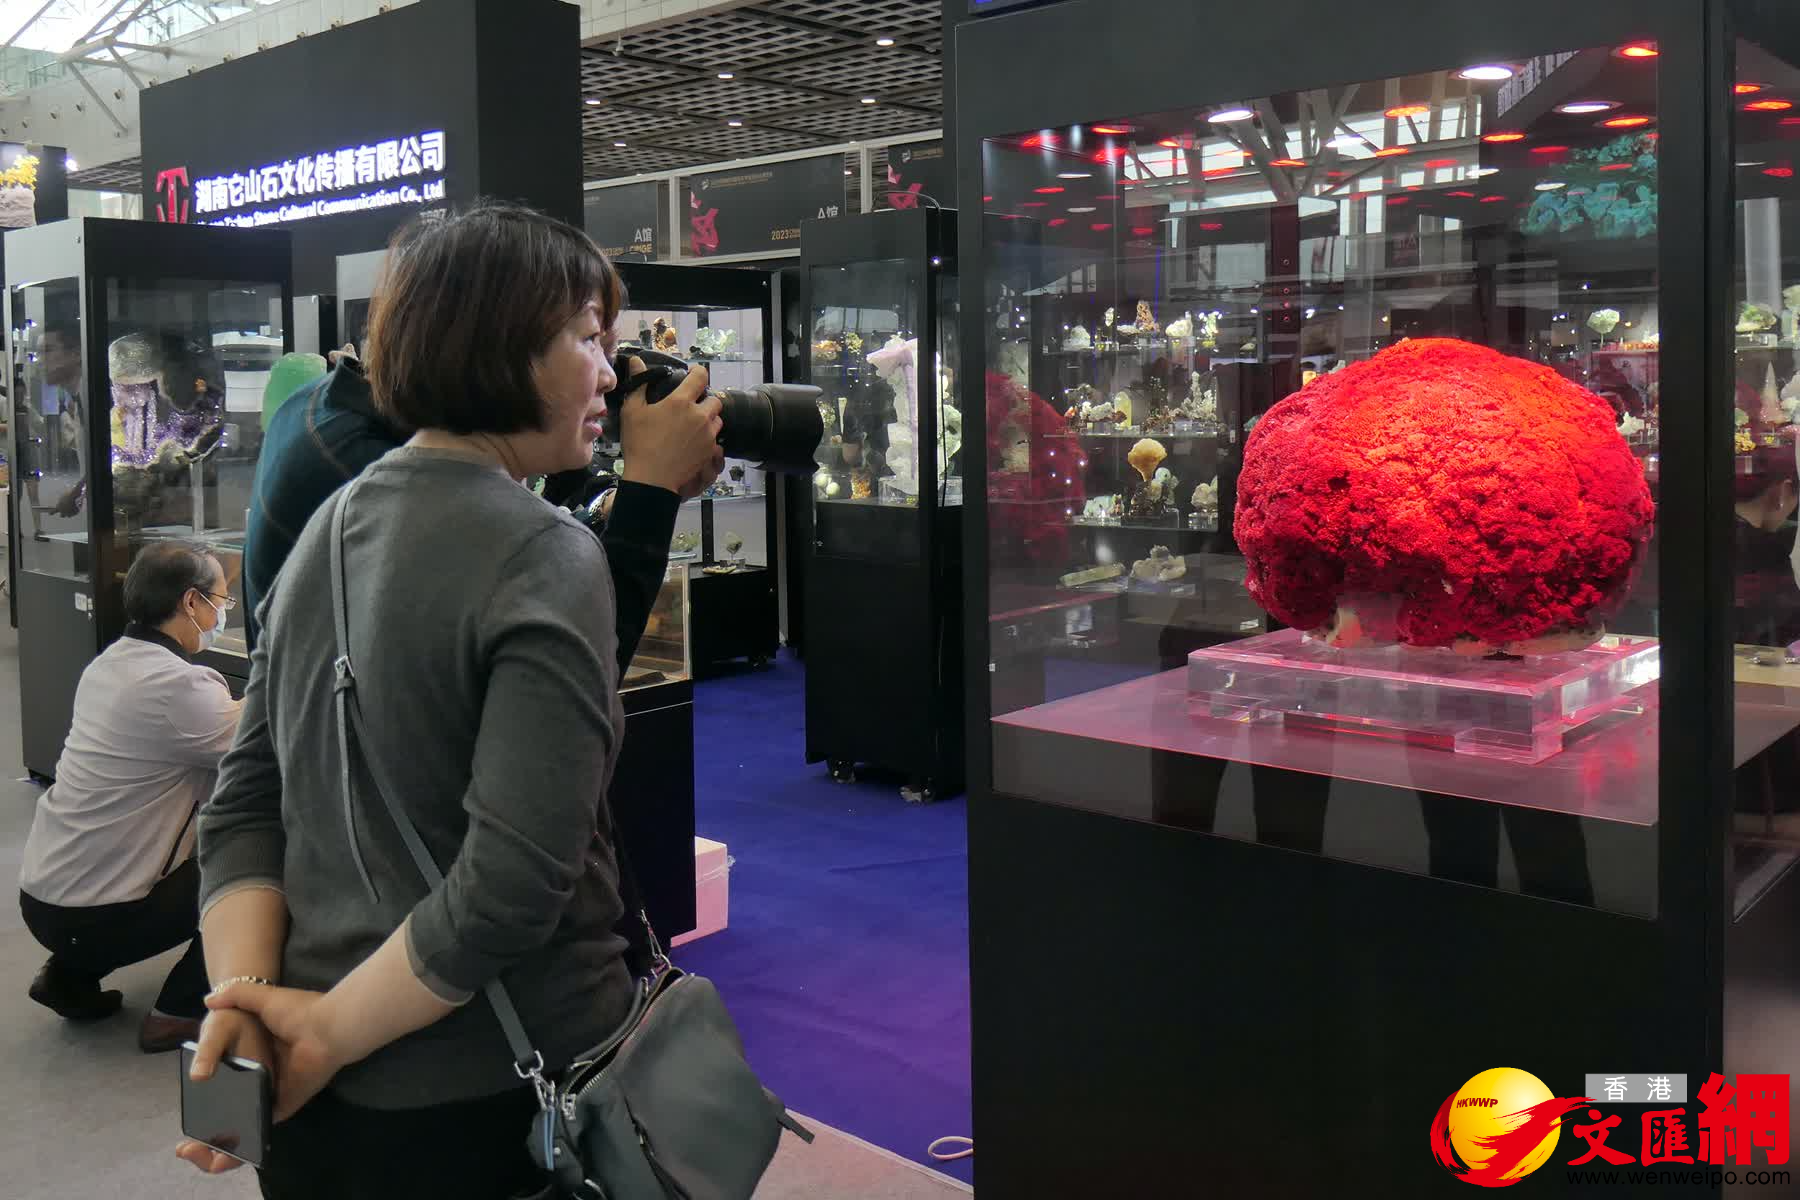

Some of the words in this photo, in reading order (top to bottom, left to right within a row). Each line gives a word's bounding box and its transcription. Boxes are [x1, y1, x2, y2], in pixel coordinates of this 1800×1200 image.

[195, 131, 446, 213] 湖南它山石文化传播有限公司
[279, 200, 317, 221] Cultural
[317, 189, 400, 215] Communication
[400, 185, 422, 203] Co.,
[771, 229, 789, 240] 2023
